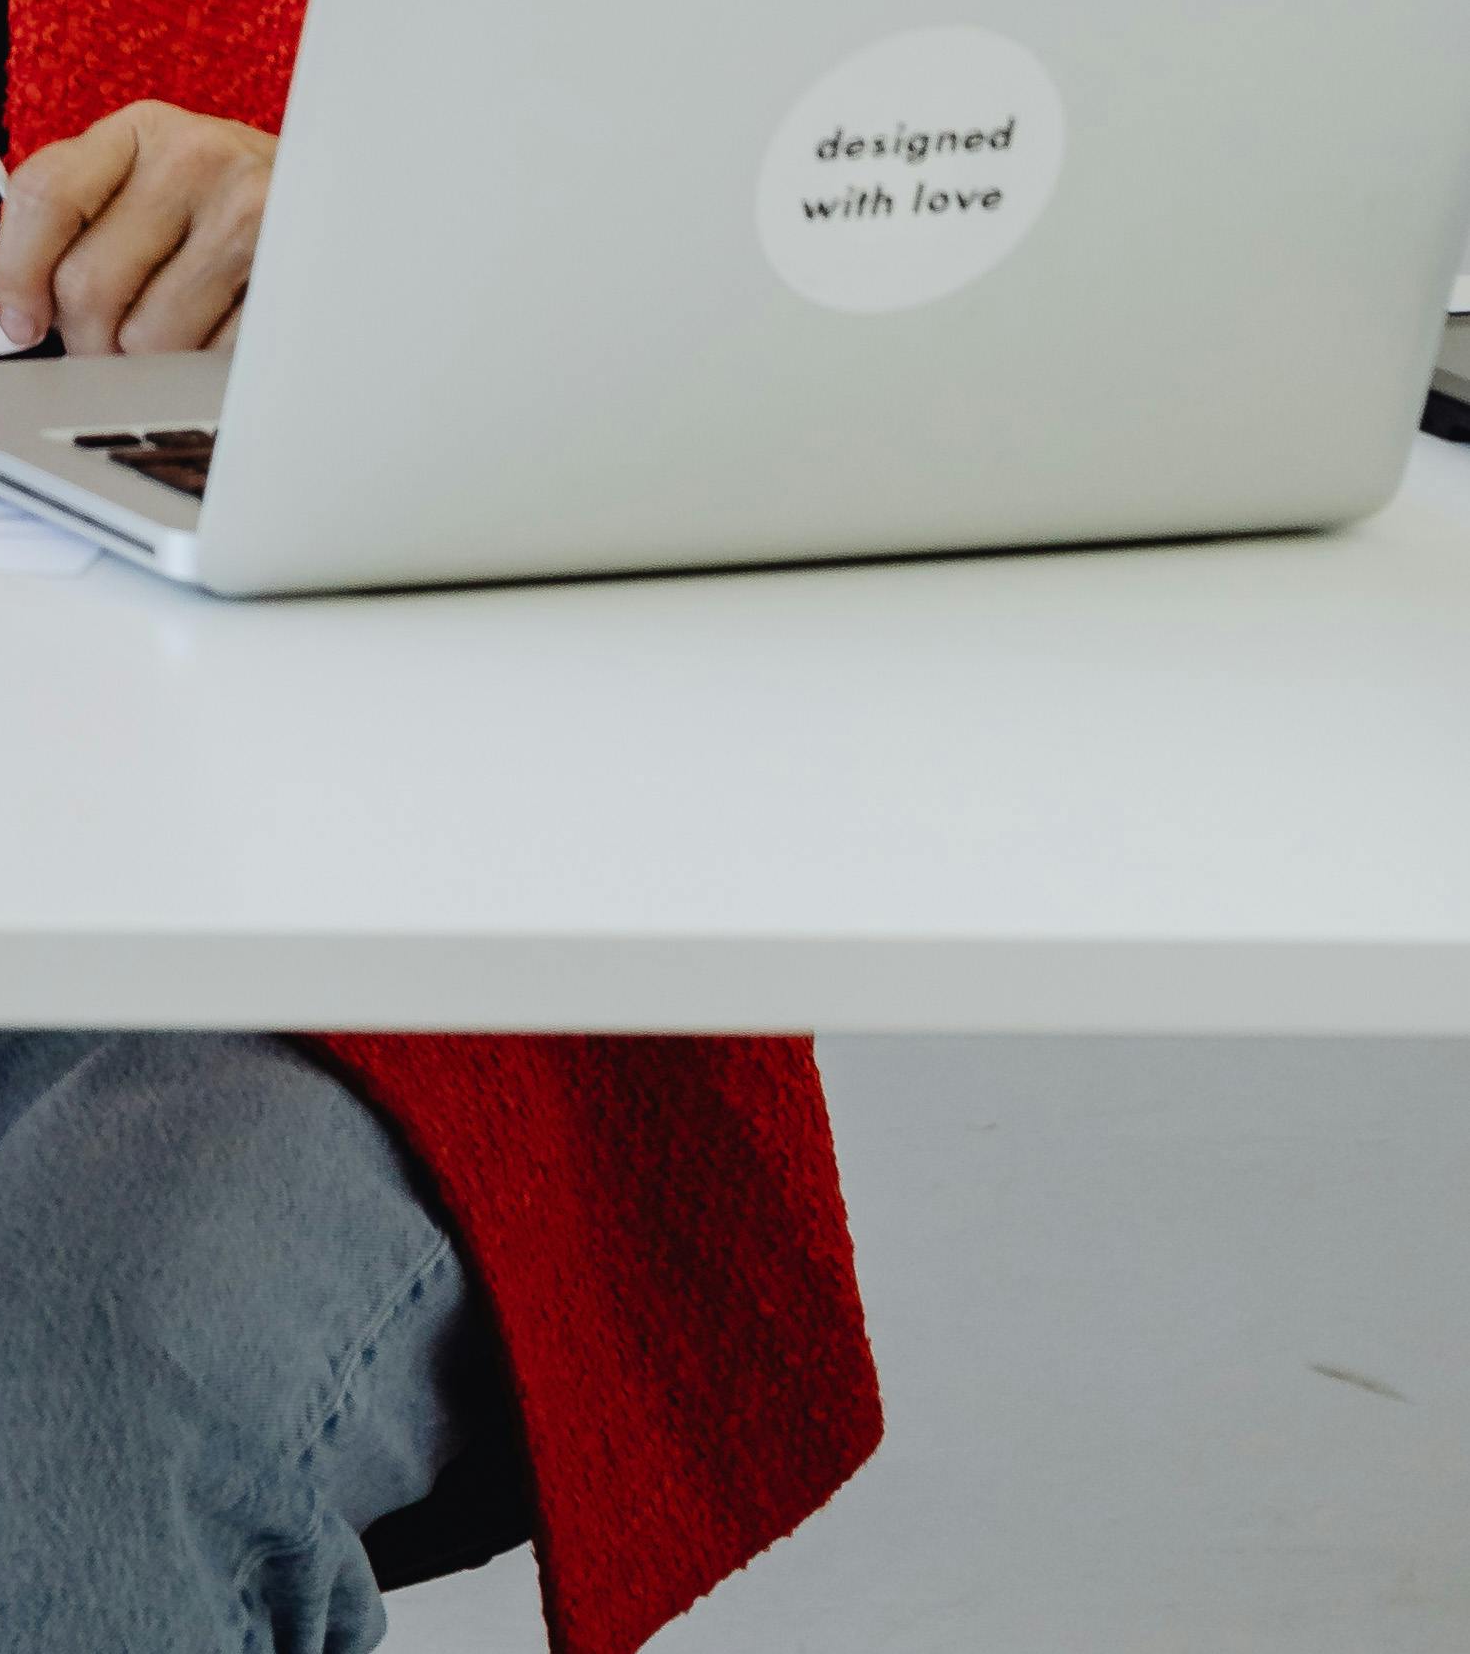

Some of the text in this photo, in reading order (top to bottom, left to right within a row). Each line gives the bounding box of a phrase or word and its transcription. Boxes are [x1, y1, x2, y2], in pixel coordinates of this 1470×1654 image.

[814, 115, 1017, 166] designed
[801, 182, 1005, 222] with love
